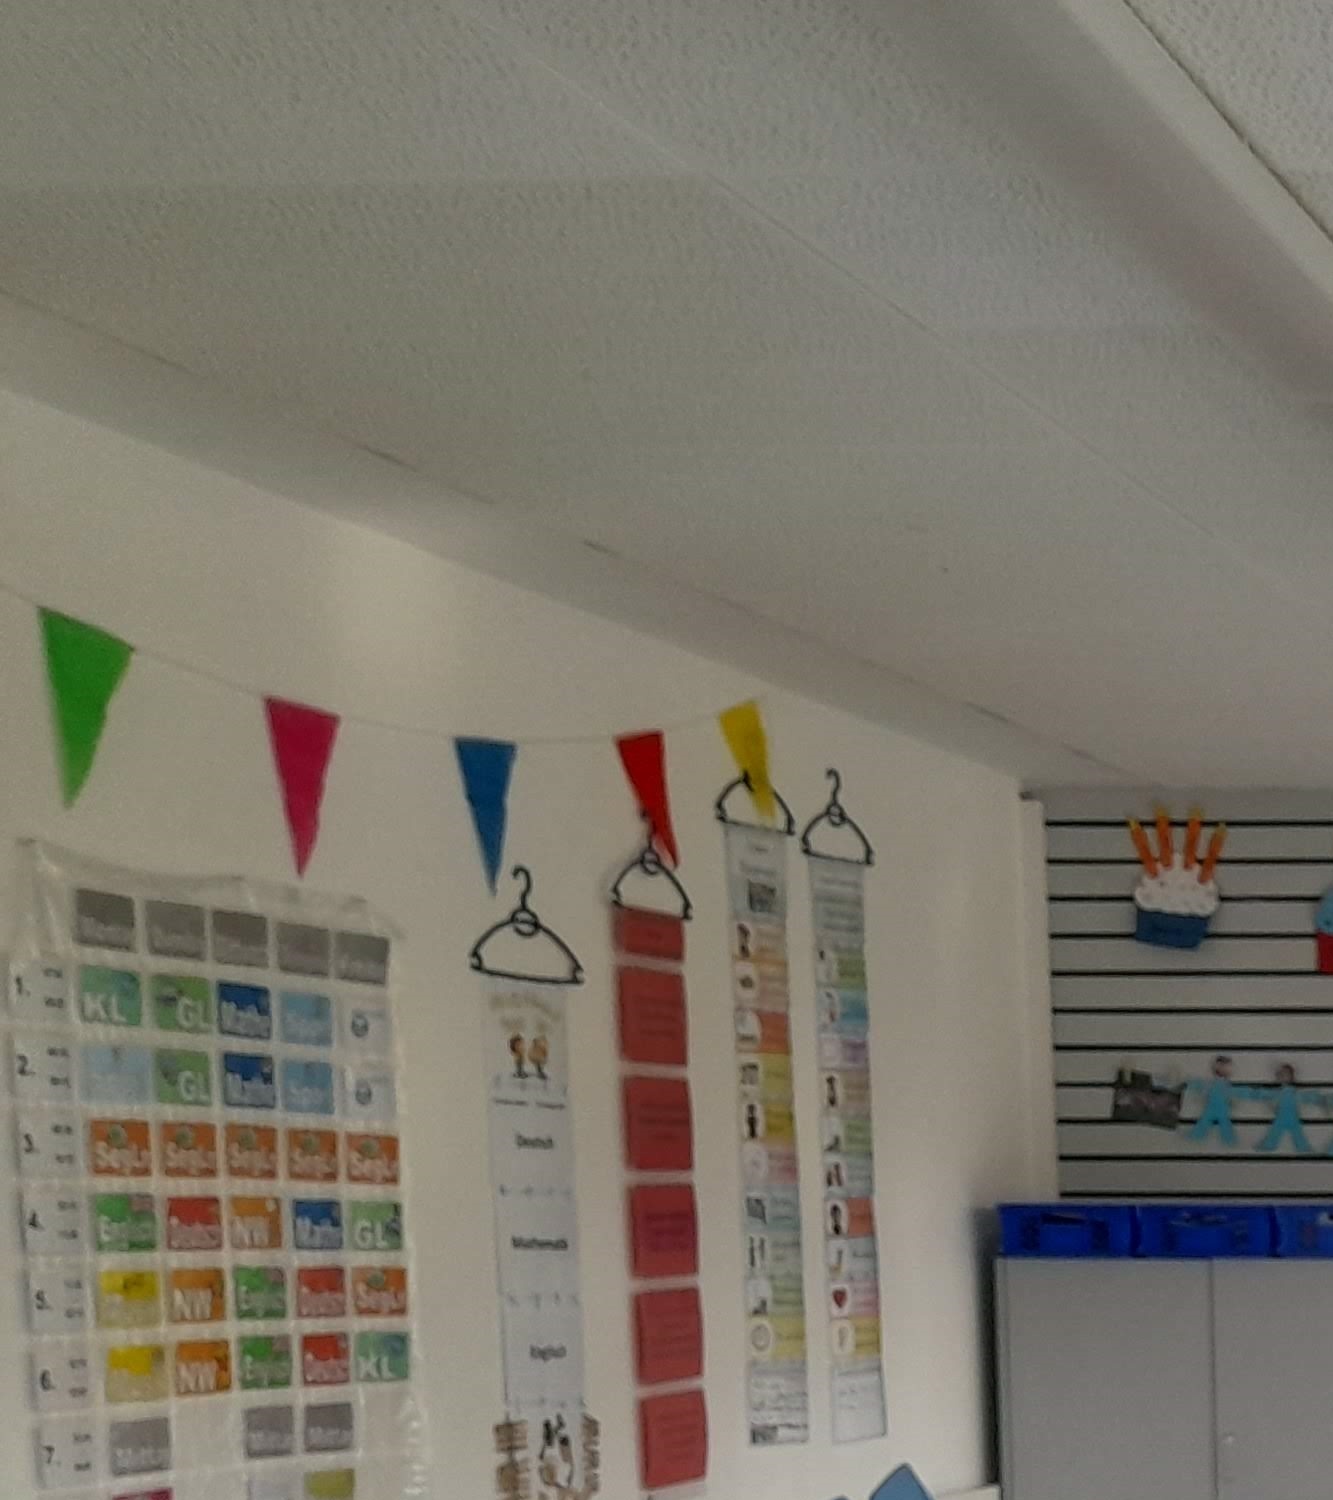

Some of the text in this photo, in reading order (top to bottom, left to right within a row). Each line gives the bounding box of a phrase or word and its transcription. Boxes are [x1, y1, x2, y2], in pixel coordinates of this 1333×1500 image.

[82, 992, 127, 1024] KL
[176, 996, 213, 1031] GL
[177, 1070, 210, 1102] GL
[354, 1219, 388, 1249] GL
[173, 1287, 214, 1321] NW
[177, 1360, 219, 1394] NW
